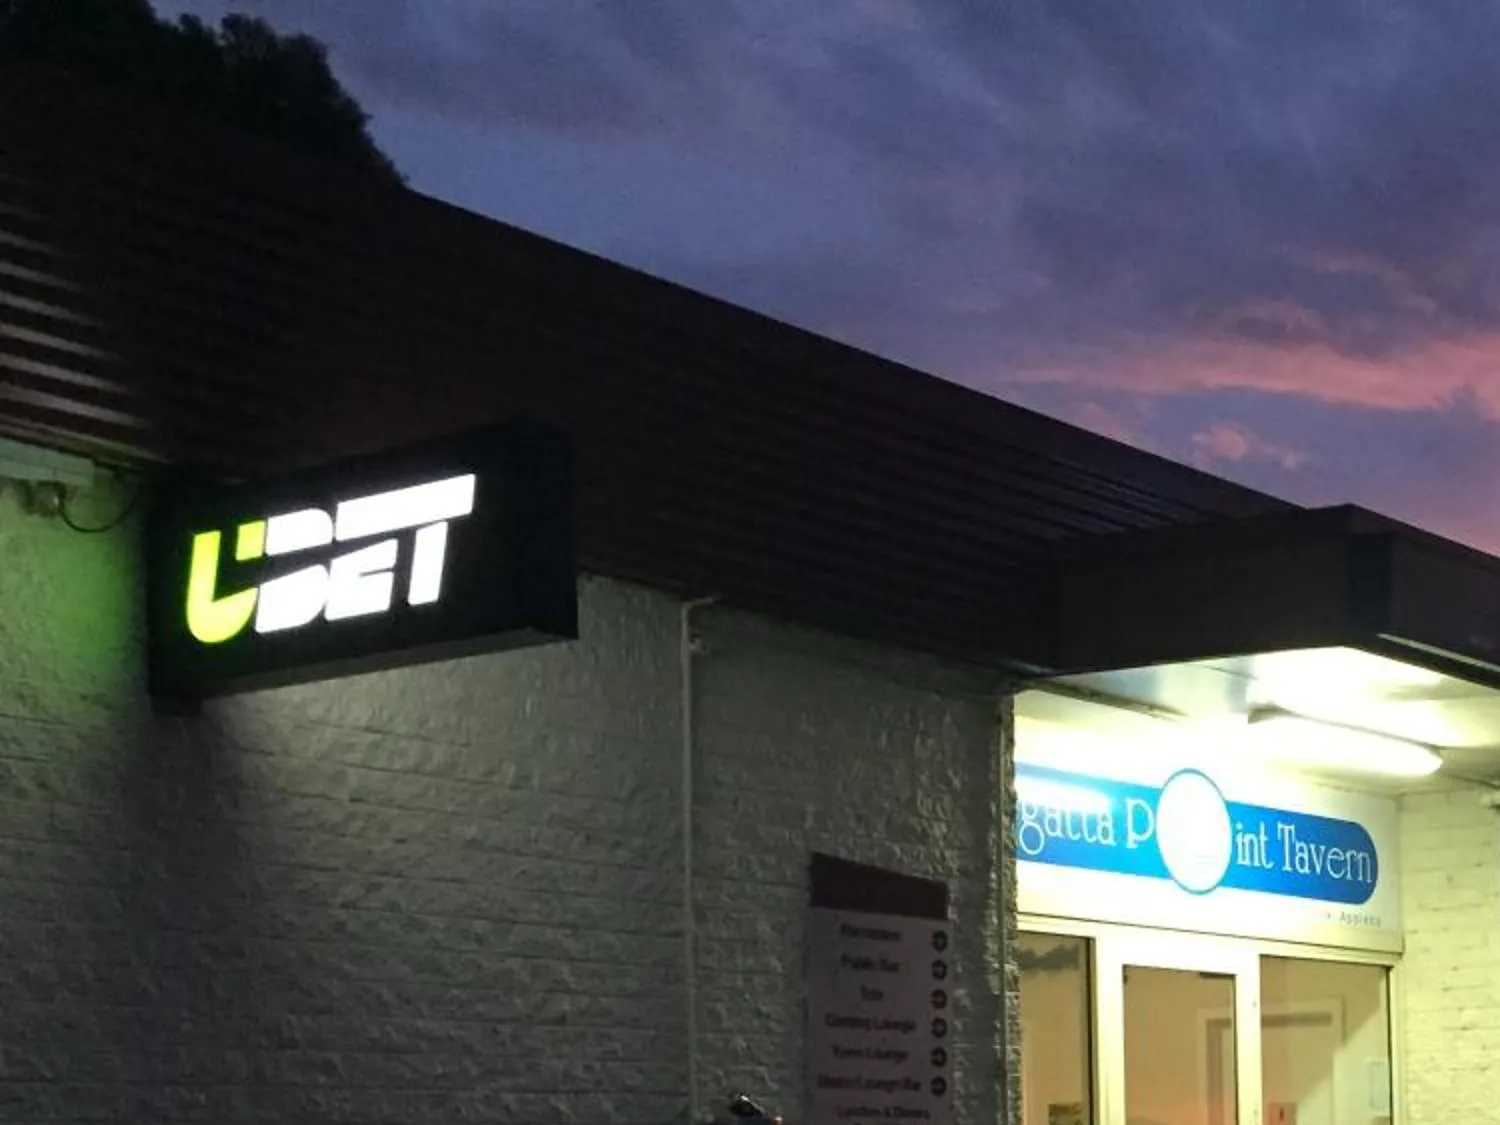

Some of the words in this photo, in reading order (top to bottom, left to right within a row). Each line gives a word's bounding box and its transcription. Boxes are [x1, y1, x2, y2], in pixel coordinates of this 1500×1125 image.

[187, 474, 476, 643] UBET
[1018, 796, 1117, 856] gatta
[1277, 823, 1374, 884] Tavern
